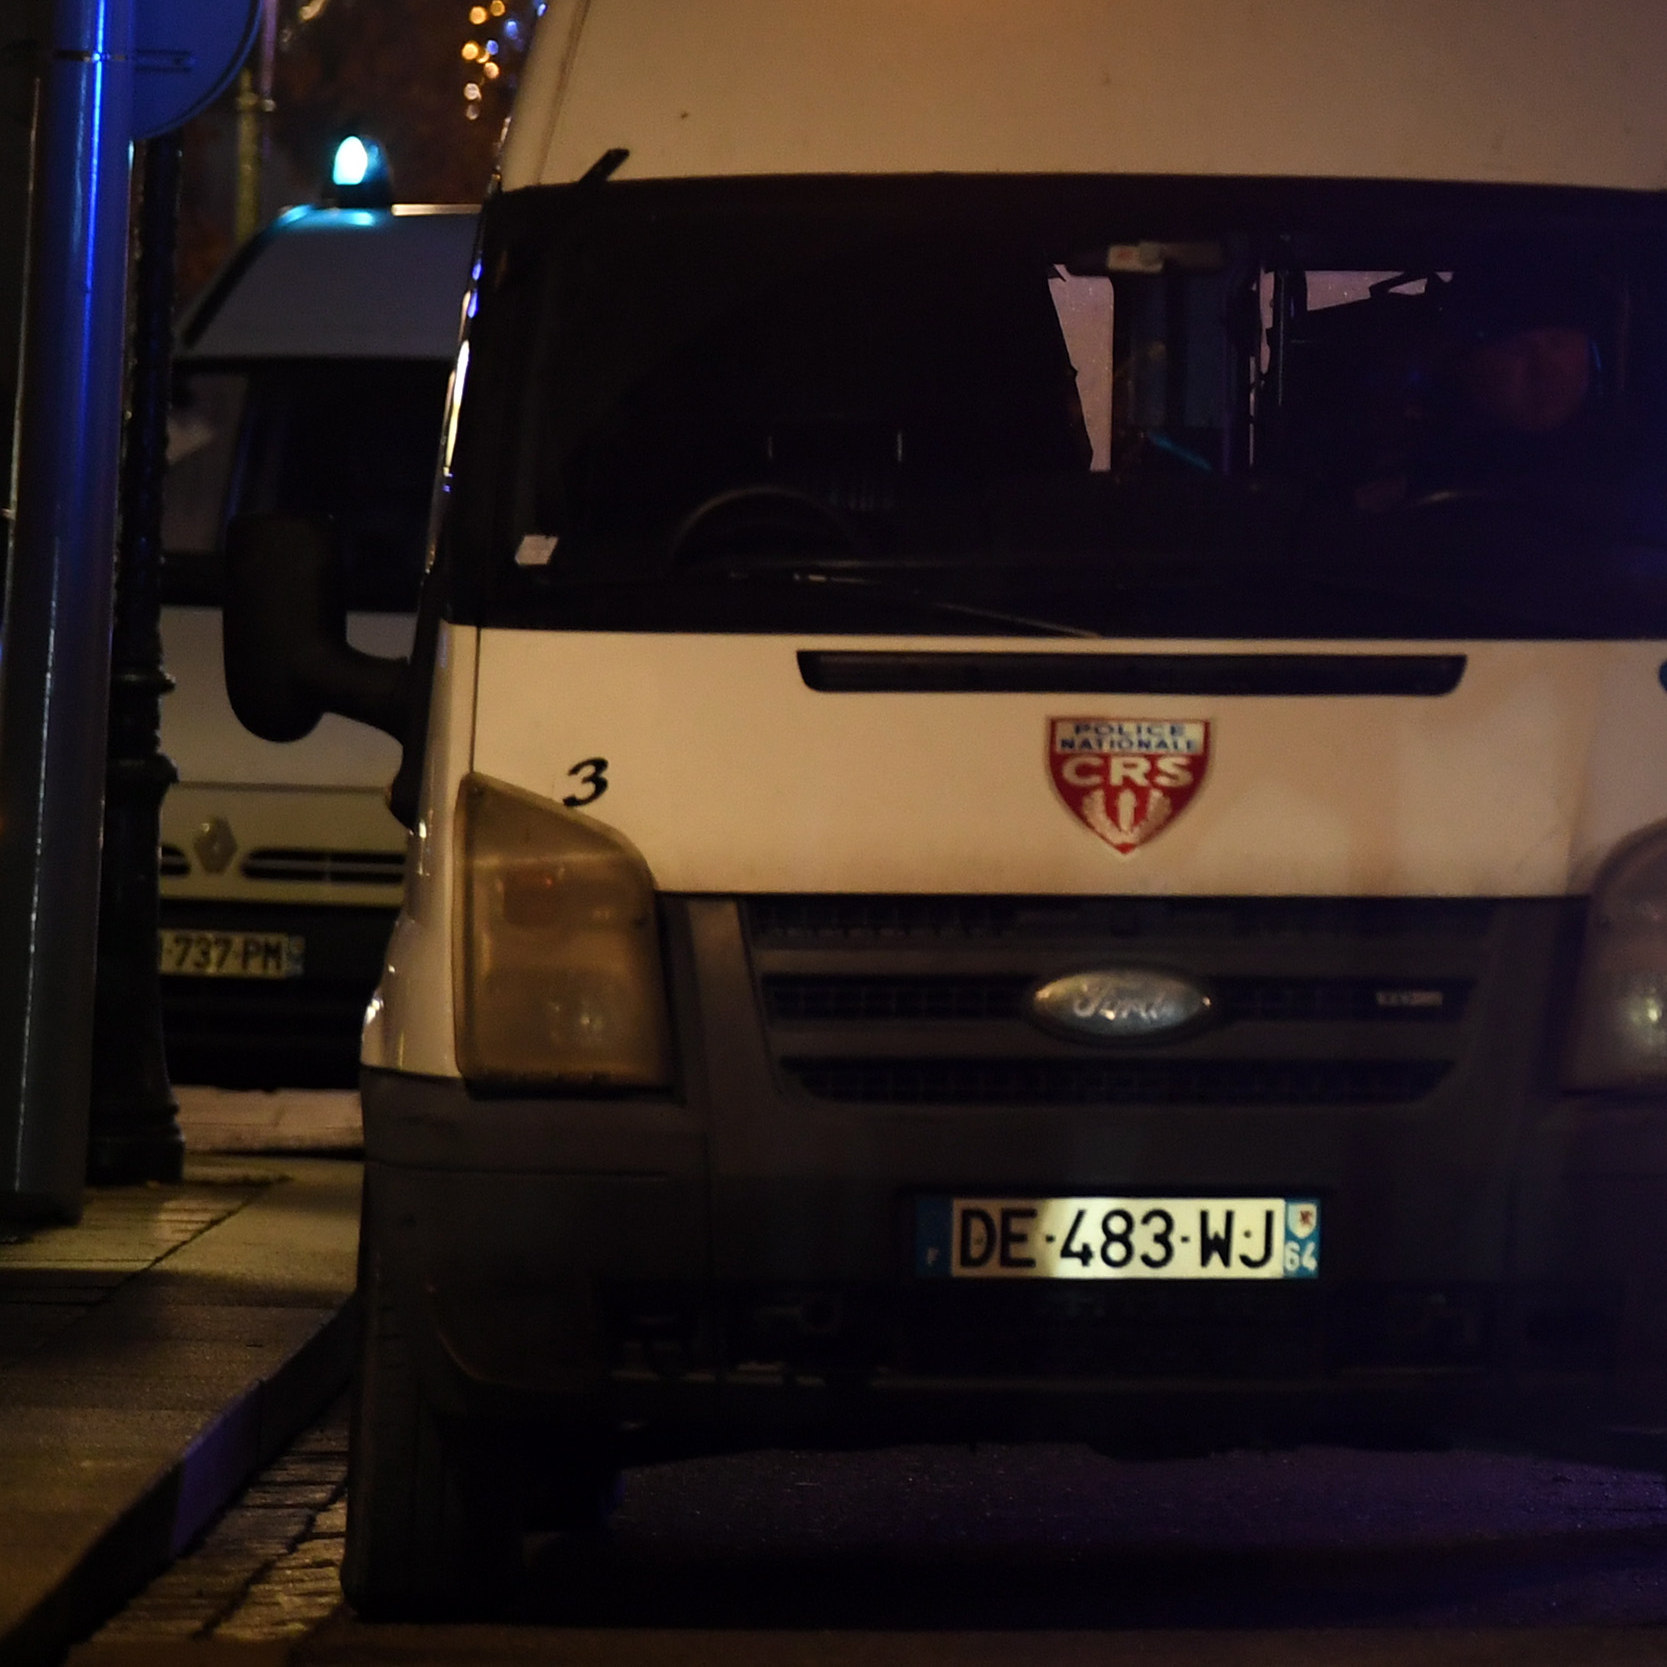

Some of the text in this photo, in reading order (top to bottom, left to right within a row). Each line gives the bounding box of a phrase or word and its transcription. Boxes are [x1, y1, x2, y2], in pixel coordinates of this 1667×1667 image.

[1060, 738, 1198, 751] NATIONALE
[1074, 723, 1187, 736] POLICE
[562, 756, 609, 808] 3
[1061, 755, 1194, 788] CRS
[158, 935, 283, 971] -737-PM
[958, 1207, 1275, 1269] DE-483-WJ
[1284, 1240, 1319, 1272] 64
